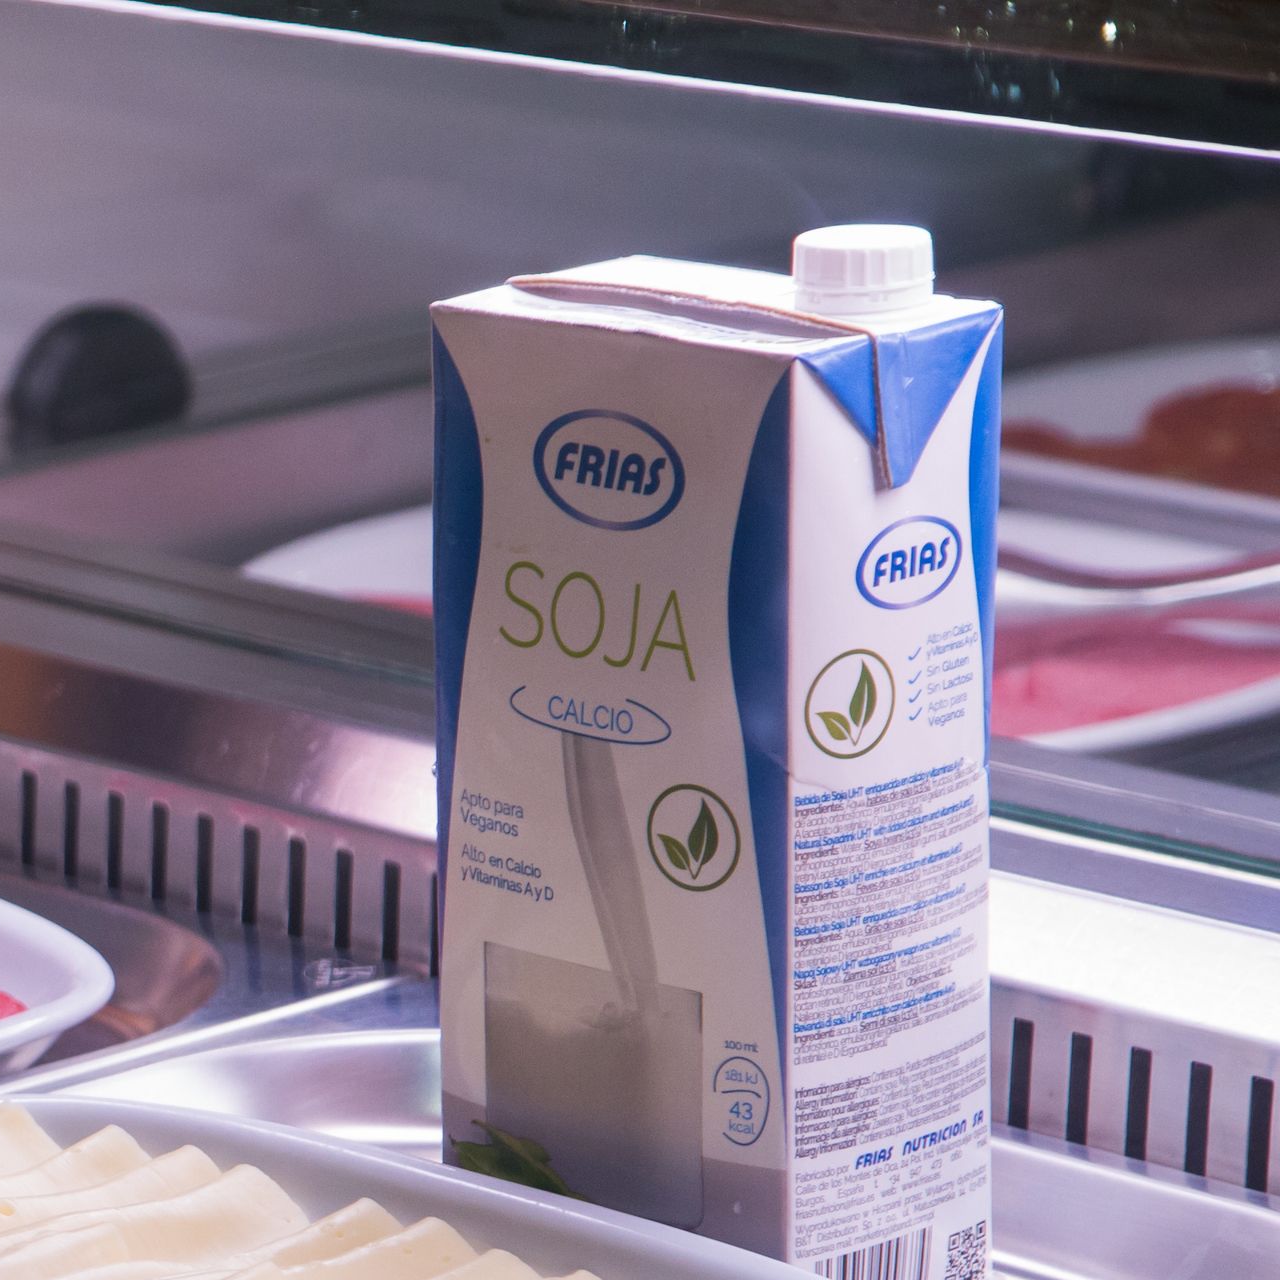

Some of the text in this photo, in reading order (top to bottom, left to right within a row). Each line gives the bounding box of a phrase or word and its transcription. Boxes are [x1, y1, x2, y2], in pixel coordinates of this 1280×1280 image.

[554, 442, 666, 496] FRIAS
[873, 536, 951, 587] FRIAS
[499, 561, 696, 681] SOJA
[953, 623, 972, 637] Calcio
[927, 656, 969, 677] Sin Gluten
[927, 672, 973, 695] Sin Lactosa
[928, 692, 967, 713] Apto para
[548, 696, 634, 734] CALCIO
[928, 708, 965, 727] Veganos
[461, 789, 524, 819] Apto para
[794, 794, 819, 806] Bebida
[821, 792, 830, 802] de
[831, 790, 847, 802] Soja
[848, 787, 863, 797] UHT
[460, 807, 519, 837] Veganos
[856, 829, 871, 838] UHT
[461, 843, 542, 879] Alto en Calcio
[461, 866, 554, 902] y Vitaminas A y D
[794, 882, 822, 893] Boisson
[823, 880, 833, 888] de
[849, 874, 864, 883] UHT
[846, 917, 860, 926] UHT
[842, 961, 857, 970] UHT
[724, 1040, 742, 1051] 100
[725, 1068, 759, 1085] 181 kJ
[729, 1101, 753, 1120] 43
[728, 1119, 756, 1135] kcal
[795, 1167, 835, 1182] Fabricado
[836, 1166, 849, 1176] por
[855, 1146, 894, 1170] FRIAS
[902, 1119, 967, 1155] NUTRICION
[972, 1110, 984, 1127] SA
[795, 1184, 817, 1195] Calle
[818, 1181, 828, 1190] de
[830, 1178, 841, 1187] los
[843, 1170, 871, 1184] Montes
[872, 1166, 882, 1176] de
